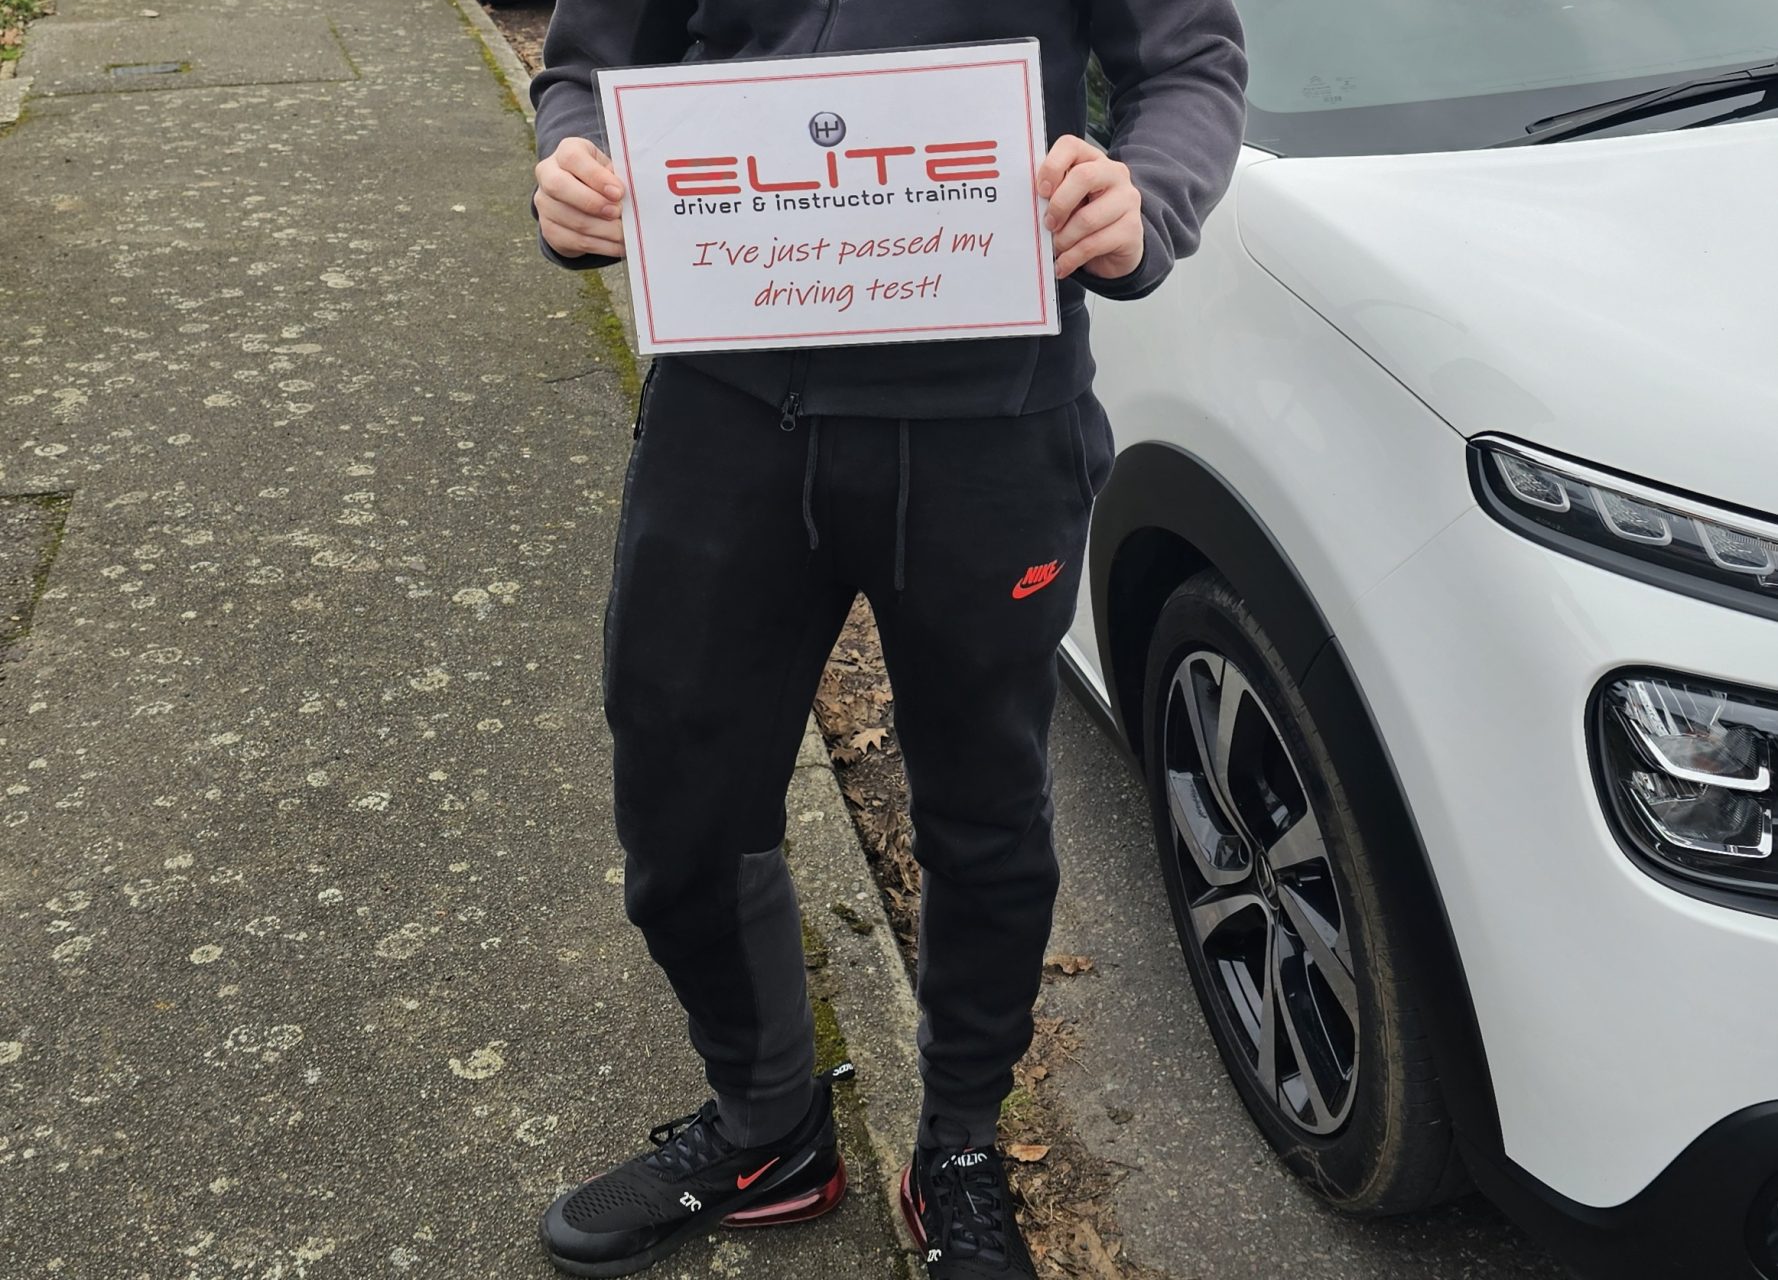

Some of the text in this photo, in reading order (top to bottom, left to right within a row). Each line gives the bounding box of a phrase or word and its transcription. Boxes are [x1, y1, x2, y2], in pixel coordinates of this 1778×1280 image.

[664, 140, 1001, 197] ELITE
[673, 182, 998, 216] driver & instructor training
[692, 226, 994, 269] I've just passed my
[754, 274, 942, 313] driving test!
[1021, 559, 1059, 585] NIKE
